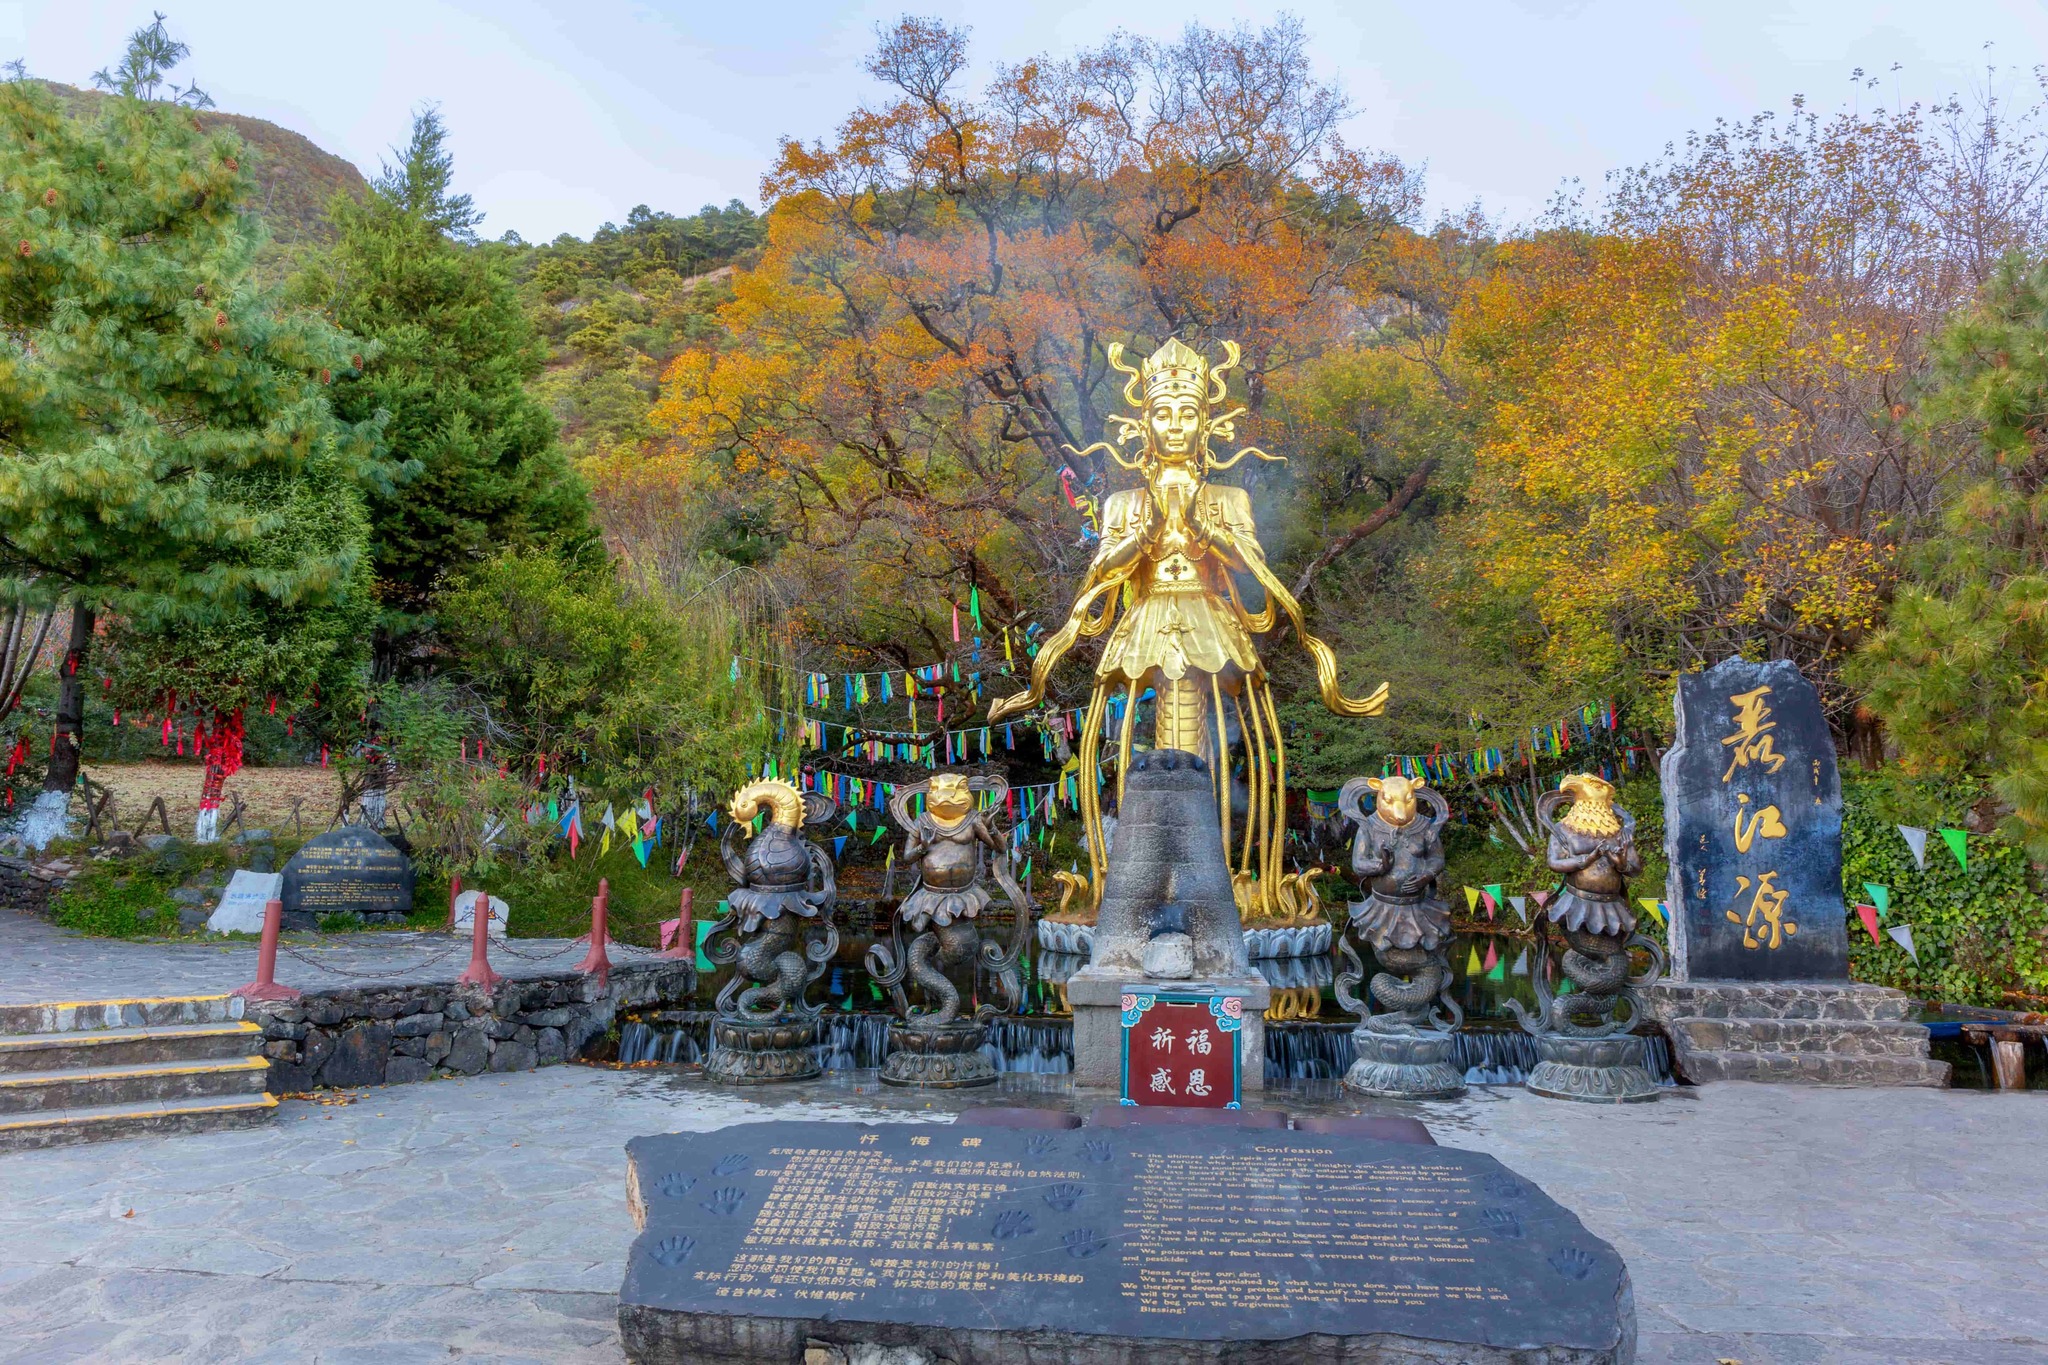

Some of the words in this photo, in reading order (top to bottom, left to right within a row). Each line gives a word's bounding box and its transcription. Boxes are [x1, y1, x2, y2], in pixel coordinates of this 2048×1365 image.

[1149, 1026, 1212, 1055] 祈福
[1149, 1066, 1212, 1097] 感恩
[1253, 1145, 1335, 1155] Confession
